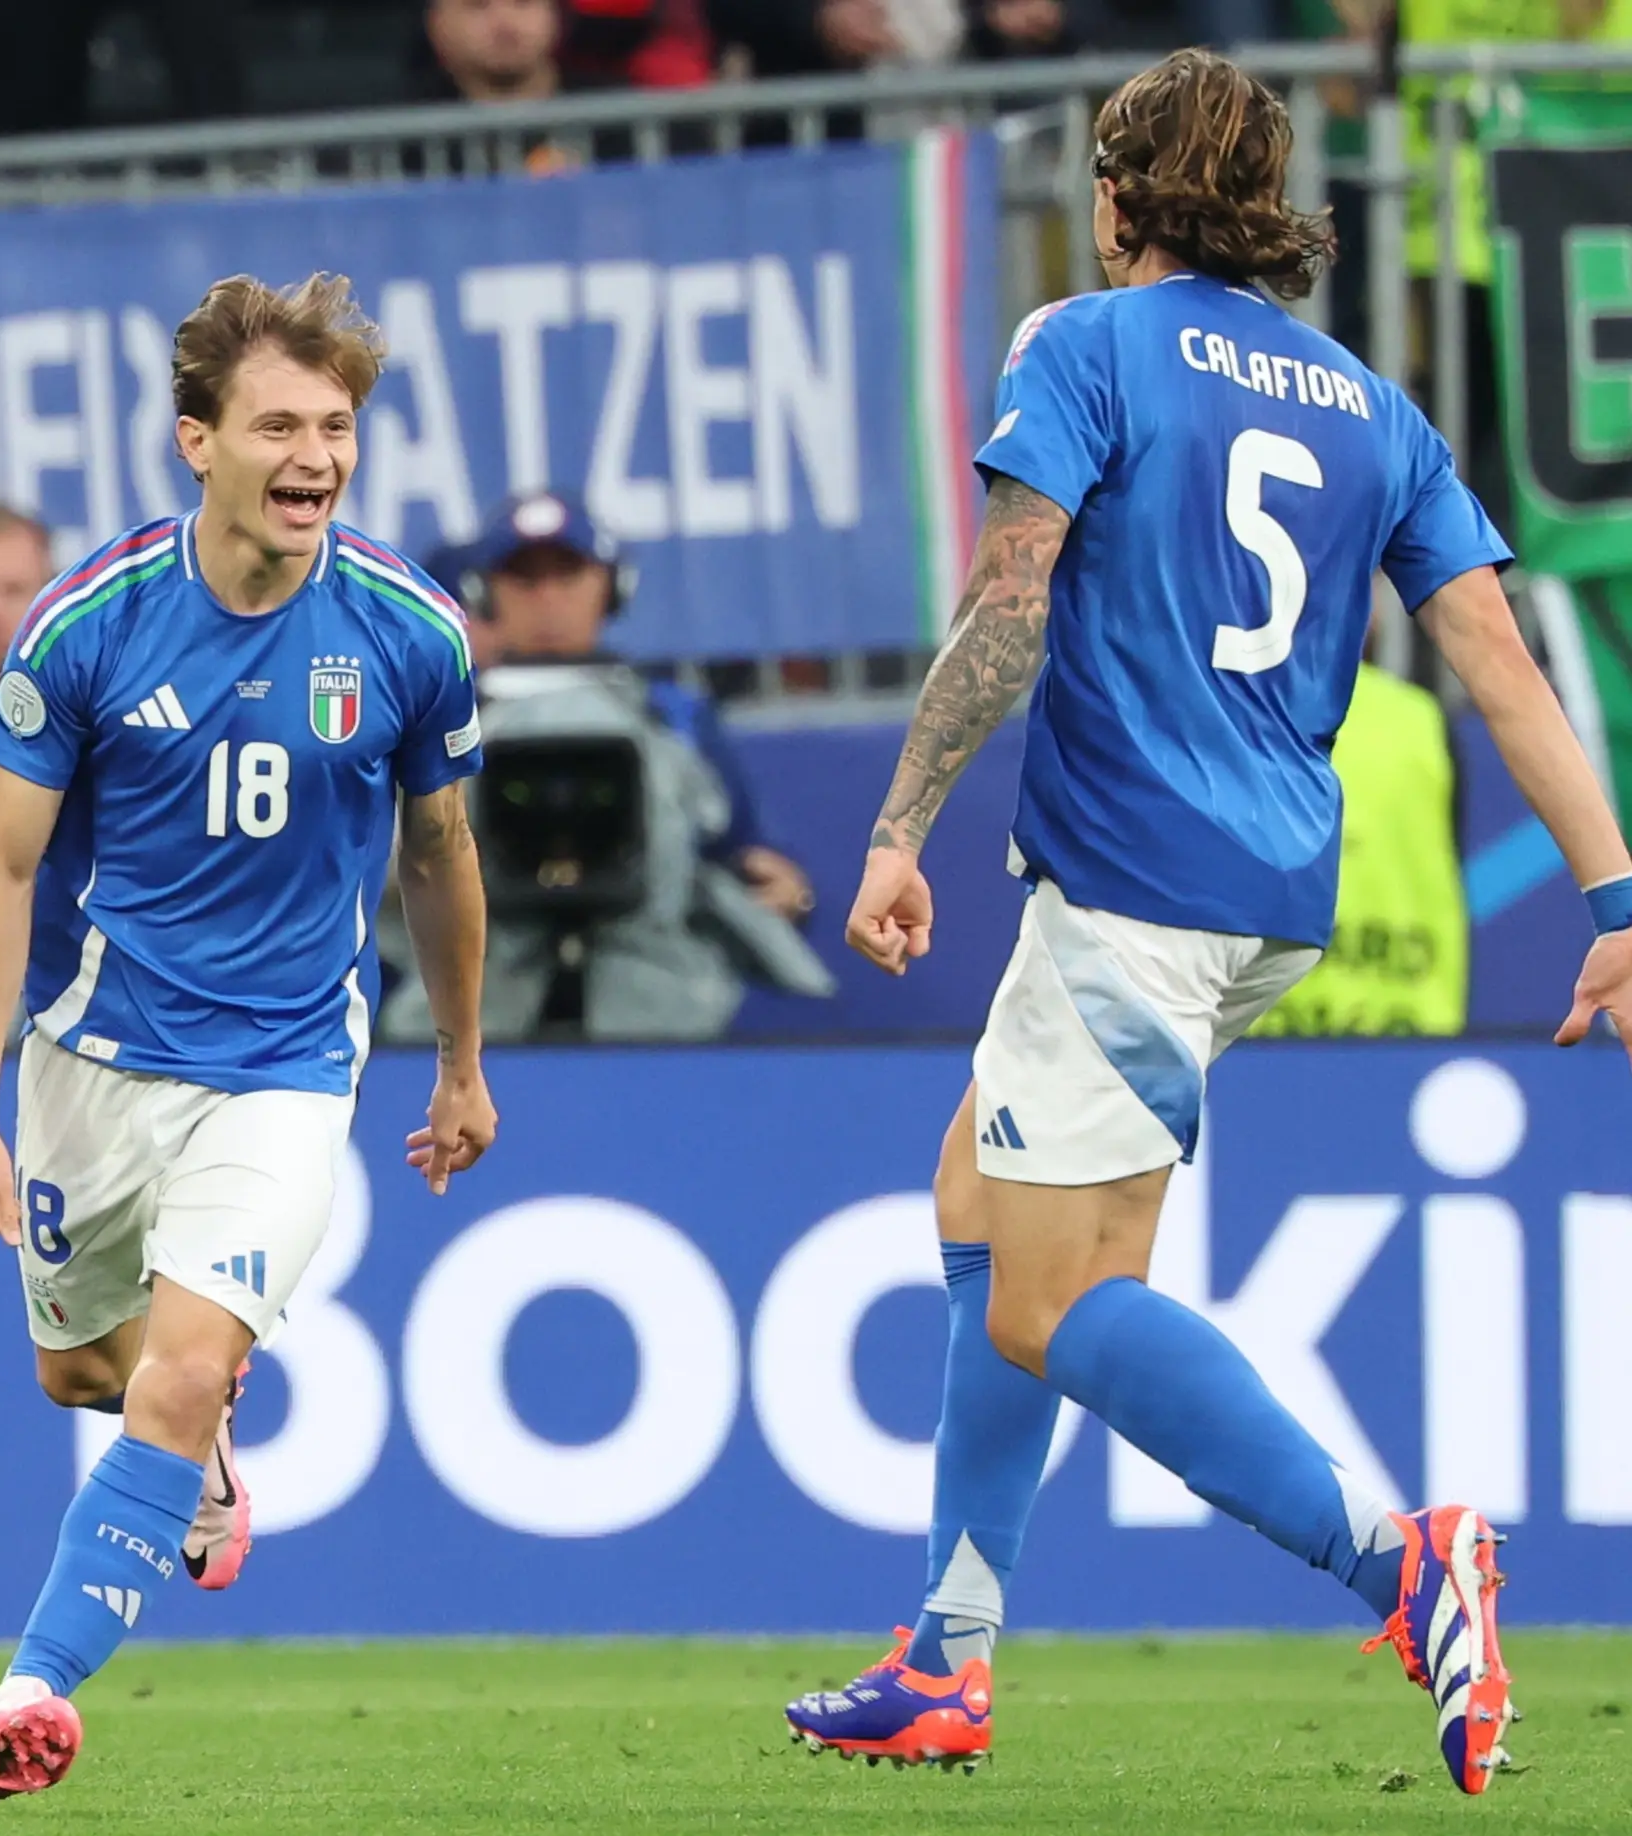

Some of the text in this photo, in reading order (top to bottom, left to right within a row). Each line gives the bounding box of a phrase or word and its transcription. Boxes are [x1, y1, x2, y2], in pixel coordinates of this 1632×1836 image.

[1180, 328, 1370, 420] CALAFIORI
[1212, 428, 1324, 675] 5
[314, 675, 356, 690] ITALIA
[206, 739, 290, 839] 18
[96, 1523, 175, 1581] ITALIA
